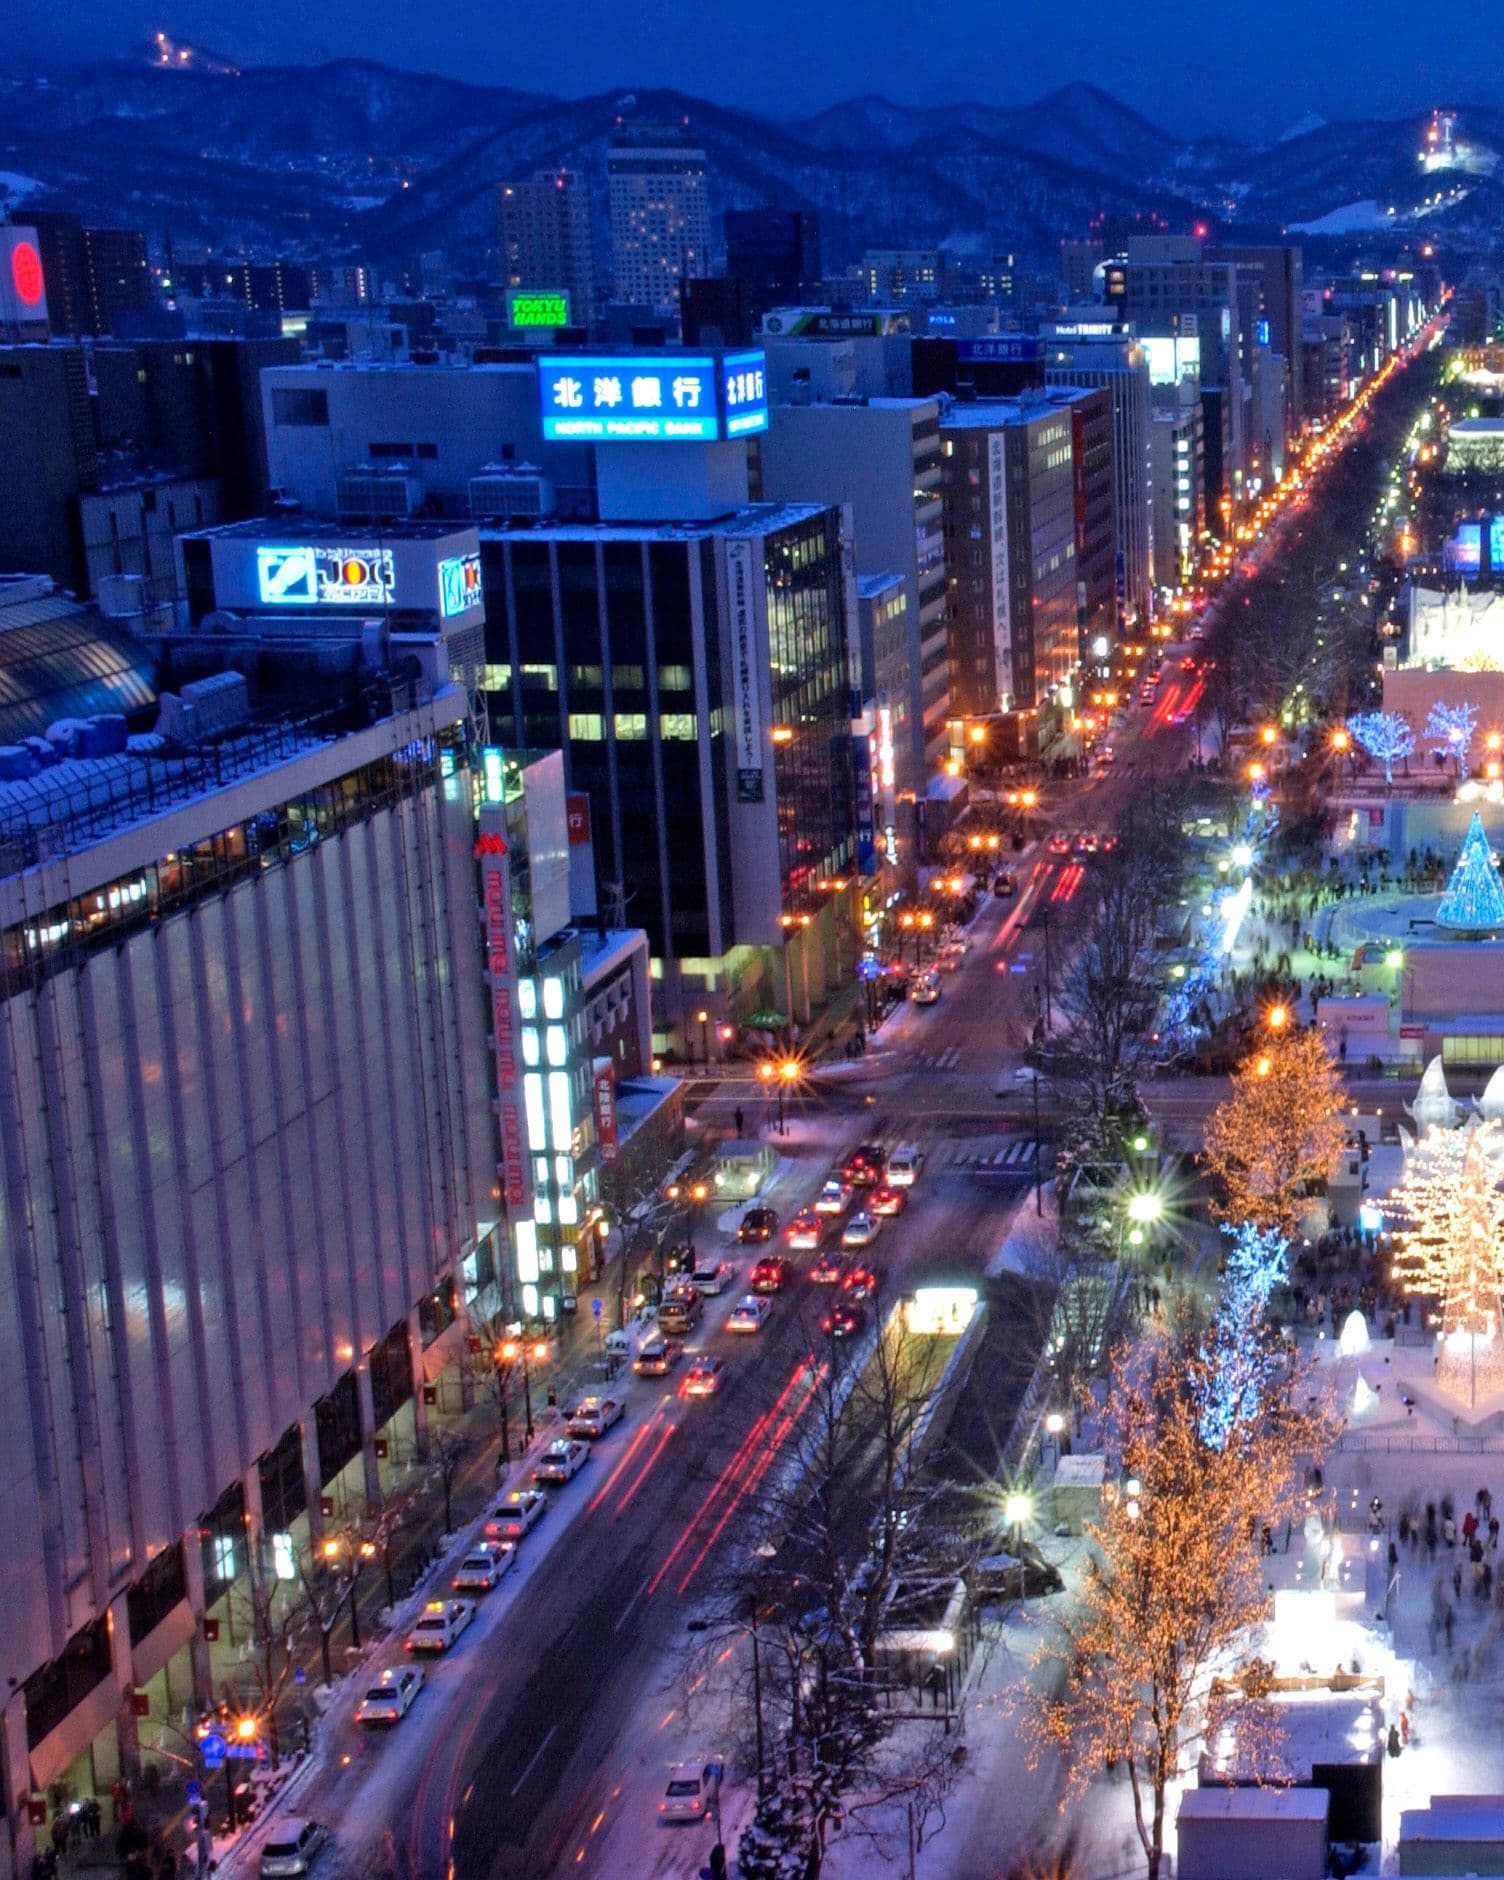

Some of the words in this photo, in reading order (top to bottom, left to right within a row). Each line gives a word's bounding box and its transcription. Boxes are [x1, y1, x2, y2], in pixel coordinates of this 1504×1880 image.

[512, 299, 567, 313] TOKYU
[513, 313, 567, 326] HANDS
[929, 315, 956, 324] POLA
[553, 376, 702, 408] 北洋銀行
[727, 371, 764, 406] 北洋銀行
[554, 421, 603, 435] NORTH
[606, 421, 661, 435] PACIFIC
[664, 422, 704, 435] BANK
